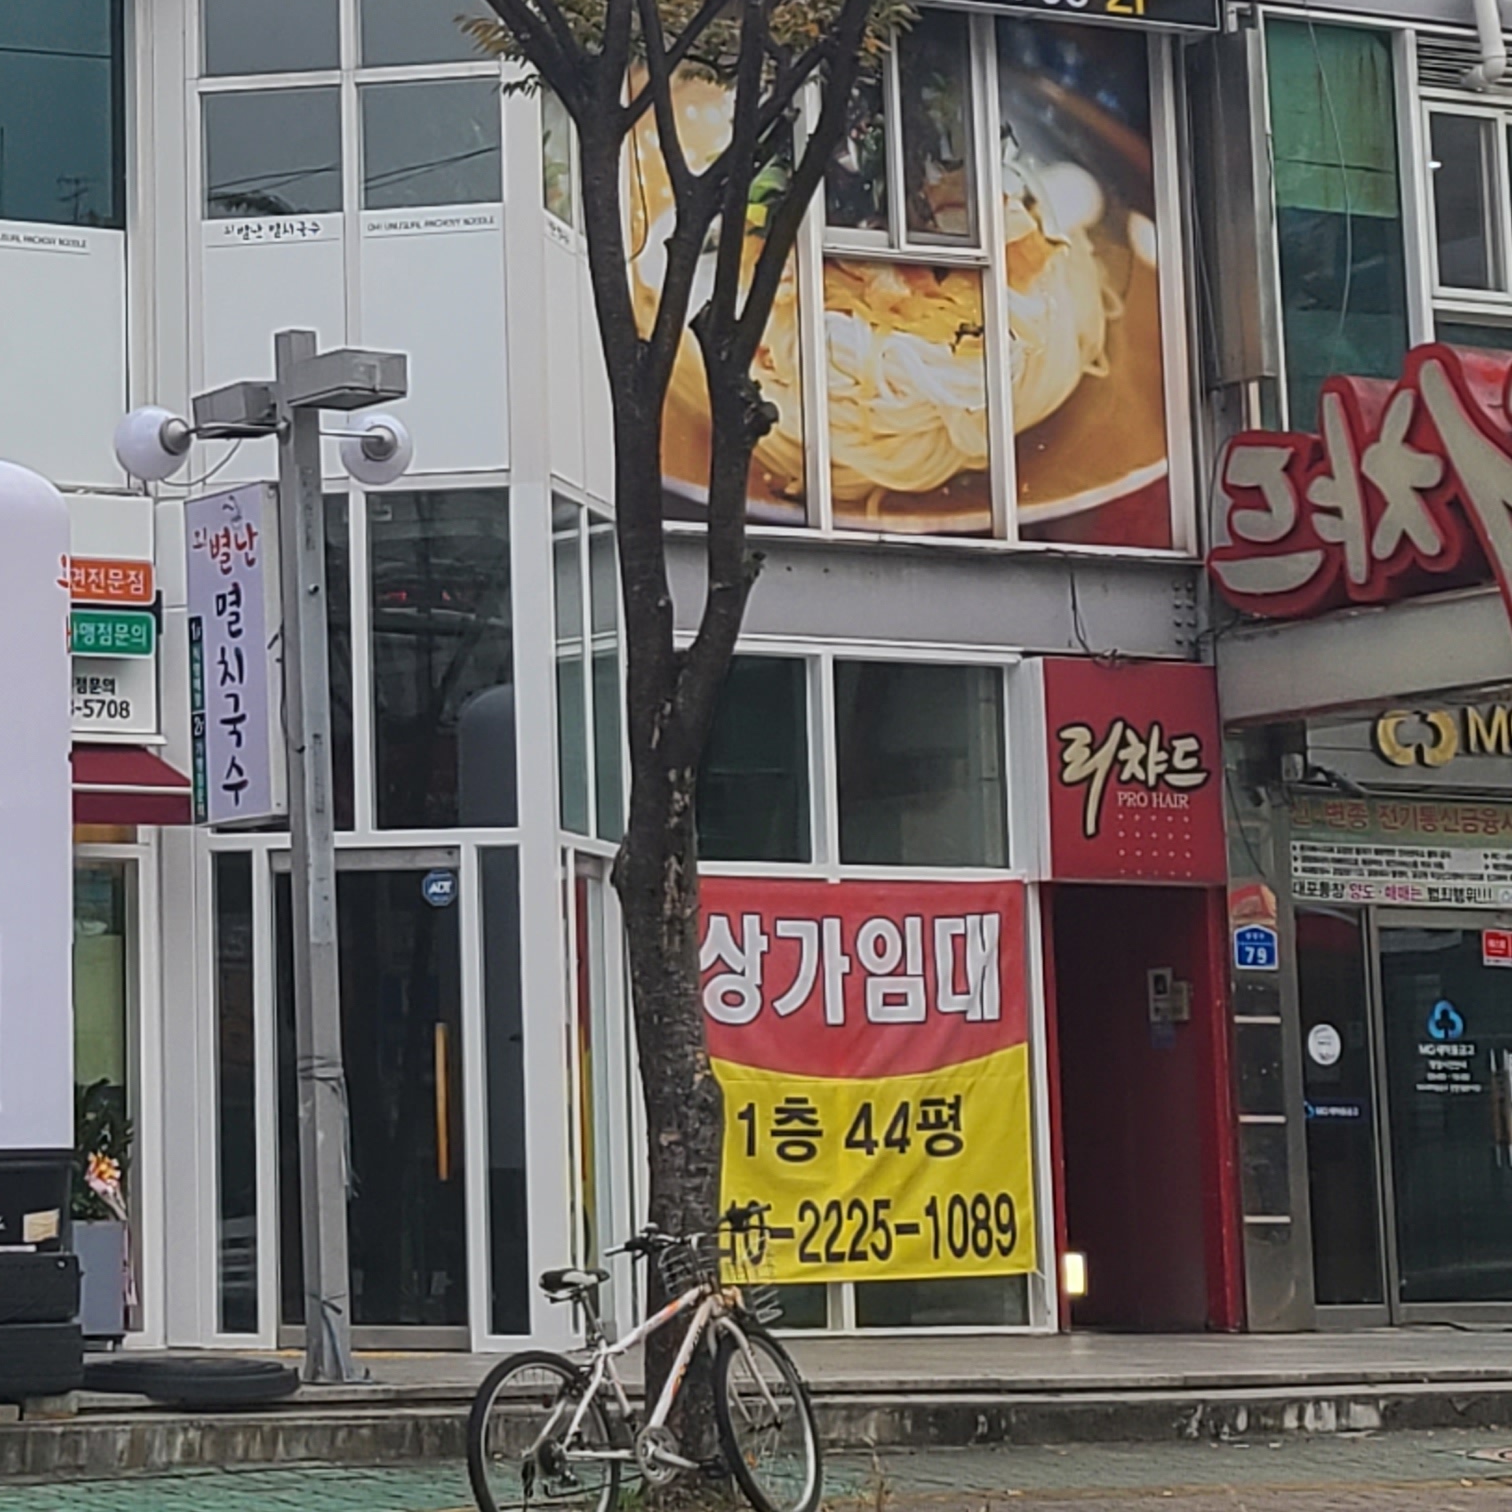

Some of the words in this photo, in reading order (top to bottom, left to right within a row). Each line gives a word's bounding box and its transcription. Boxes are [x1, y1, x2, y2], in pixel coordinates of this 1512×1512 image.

[72, 699, 131, 719] -5708
[216, 582, 248, 806] 멸치국수
[1058, 719, 1209, 837] 리챠드
[1117, 791, 1148, 808] PRO
[1152, 792, 1189, 809] HAIR
[700, 913, 1002, 1026] 상가임대
[1244, 946, 1268, 964] 79
[737, 1096, 824, 1163] 1층
[844, 1094, 965, 1158] 44평
